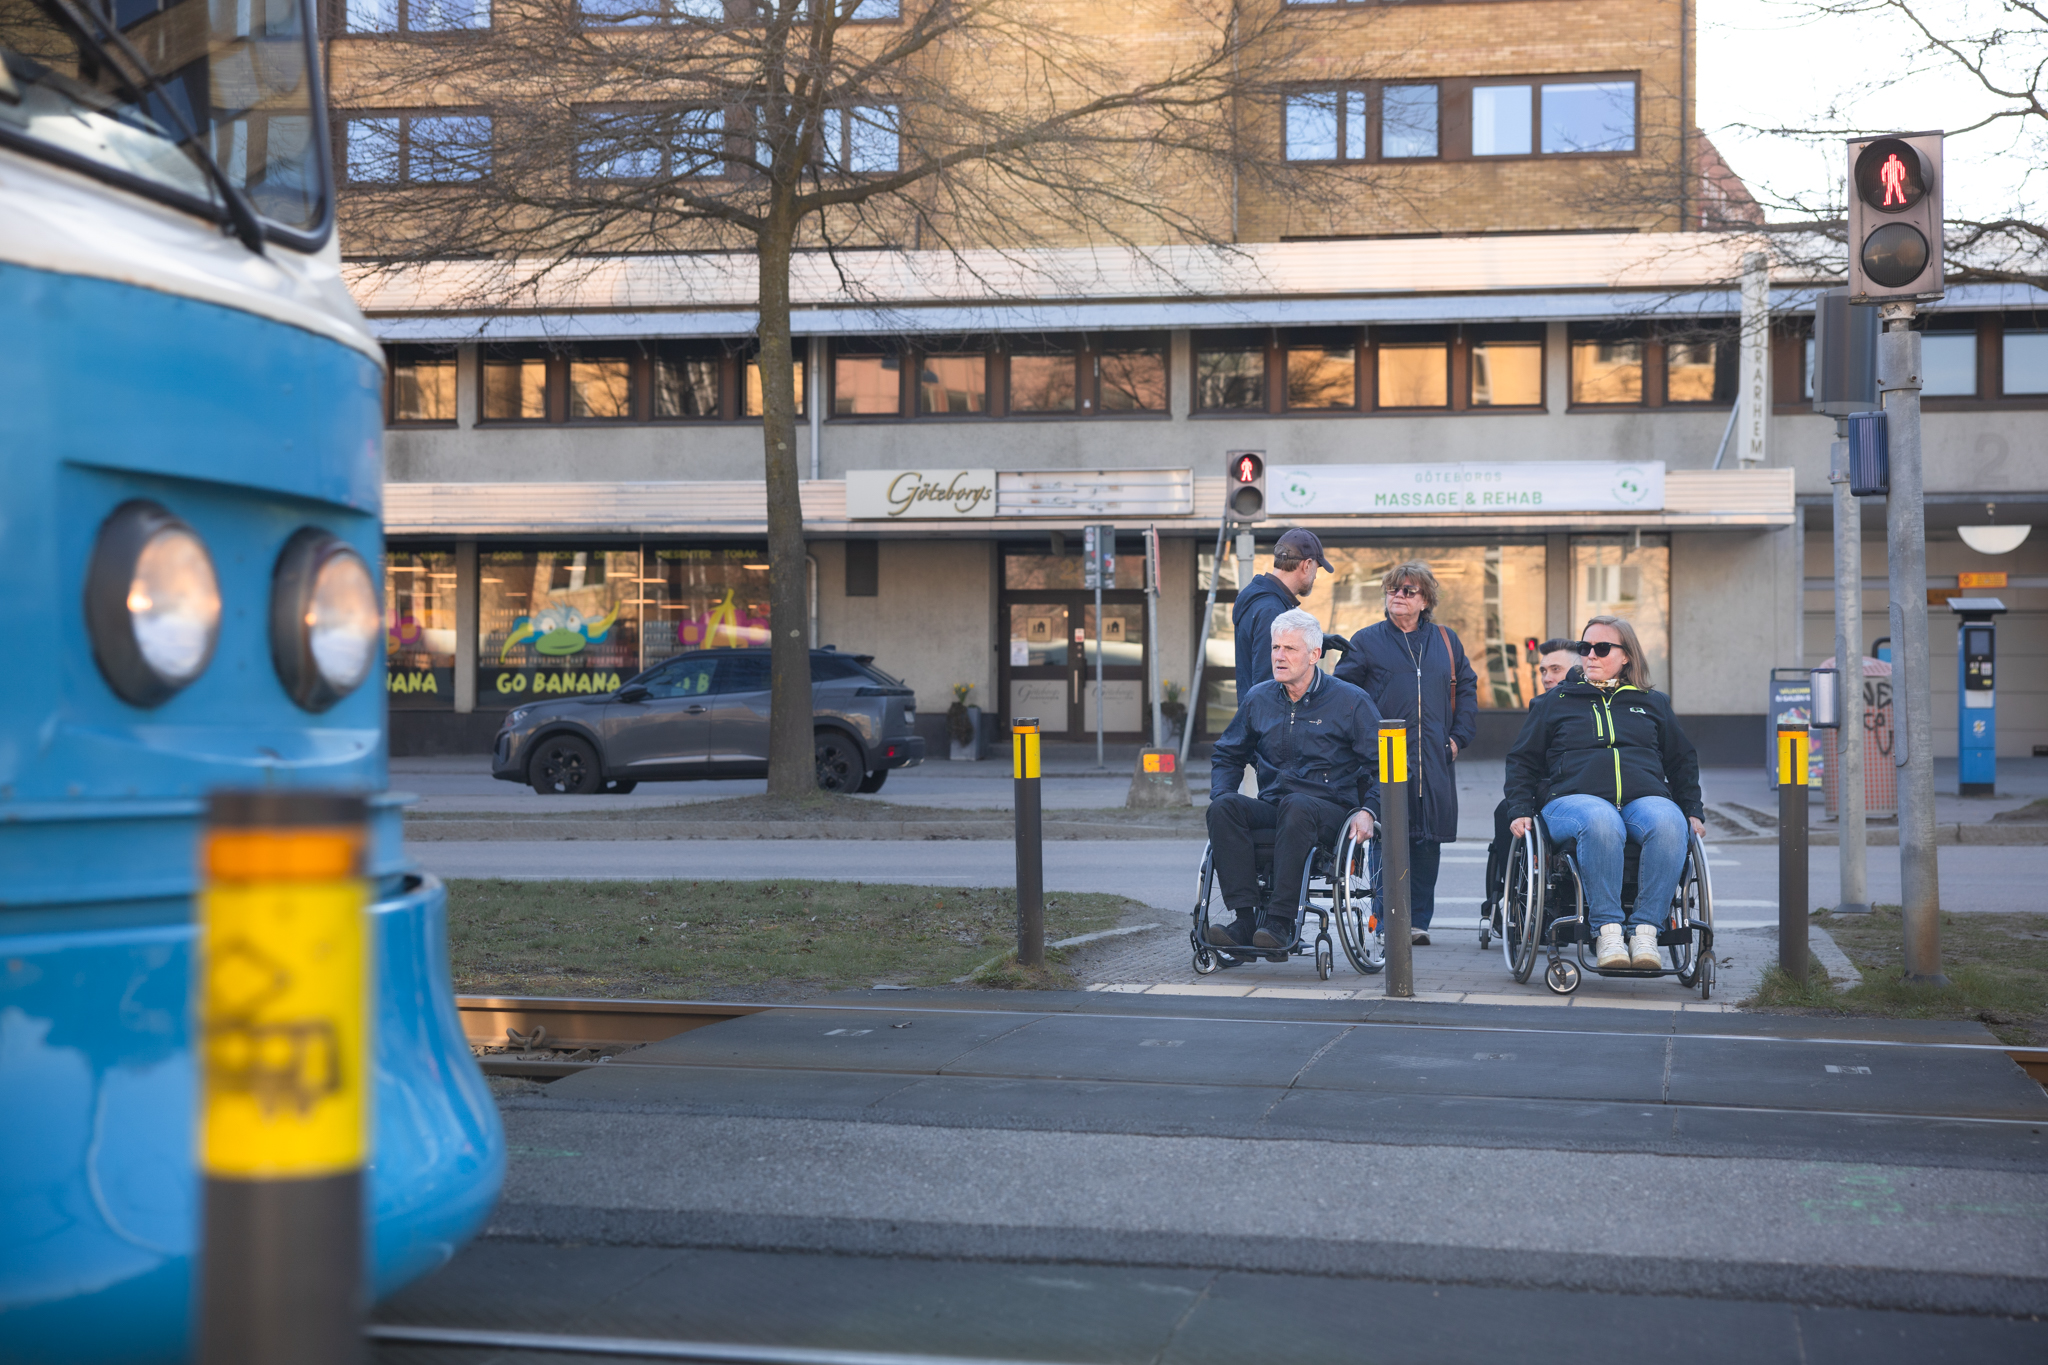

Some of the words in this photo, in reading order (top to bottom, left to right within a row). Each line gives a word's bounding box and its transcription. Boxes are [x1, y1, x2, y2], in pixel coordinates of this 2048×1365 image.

[1415, 470, 1503, 483] GÖTEBORGS
[887, 470, 992, 516] Göteborgs
[1375, 492, 1458, 506] MASSAGE
[1465, 491, 1477, 505] &
[1483, 491, 1543, 505] REHAB
[655, 550, 711, 559] PRESENTER
[723, 550, 758, 559] TOBAK
[496, 673, 527, 694] GO
[533, 672, 621, 694] BANANA
